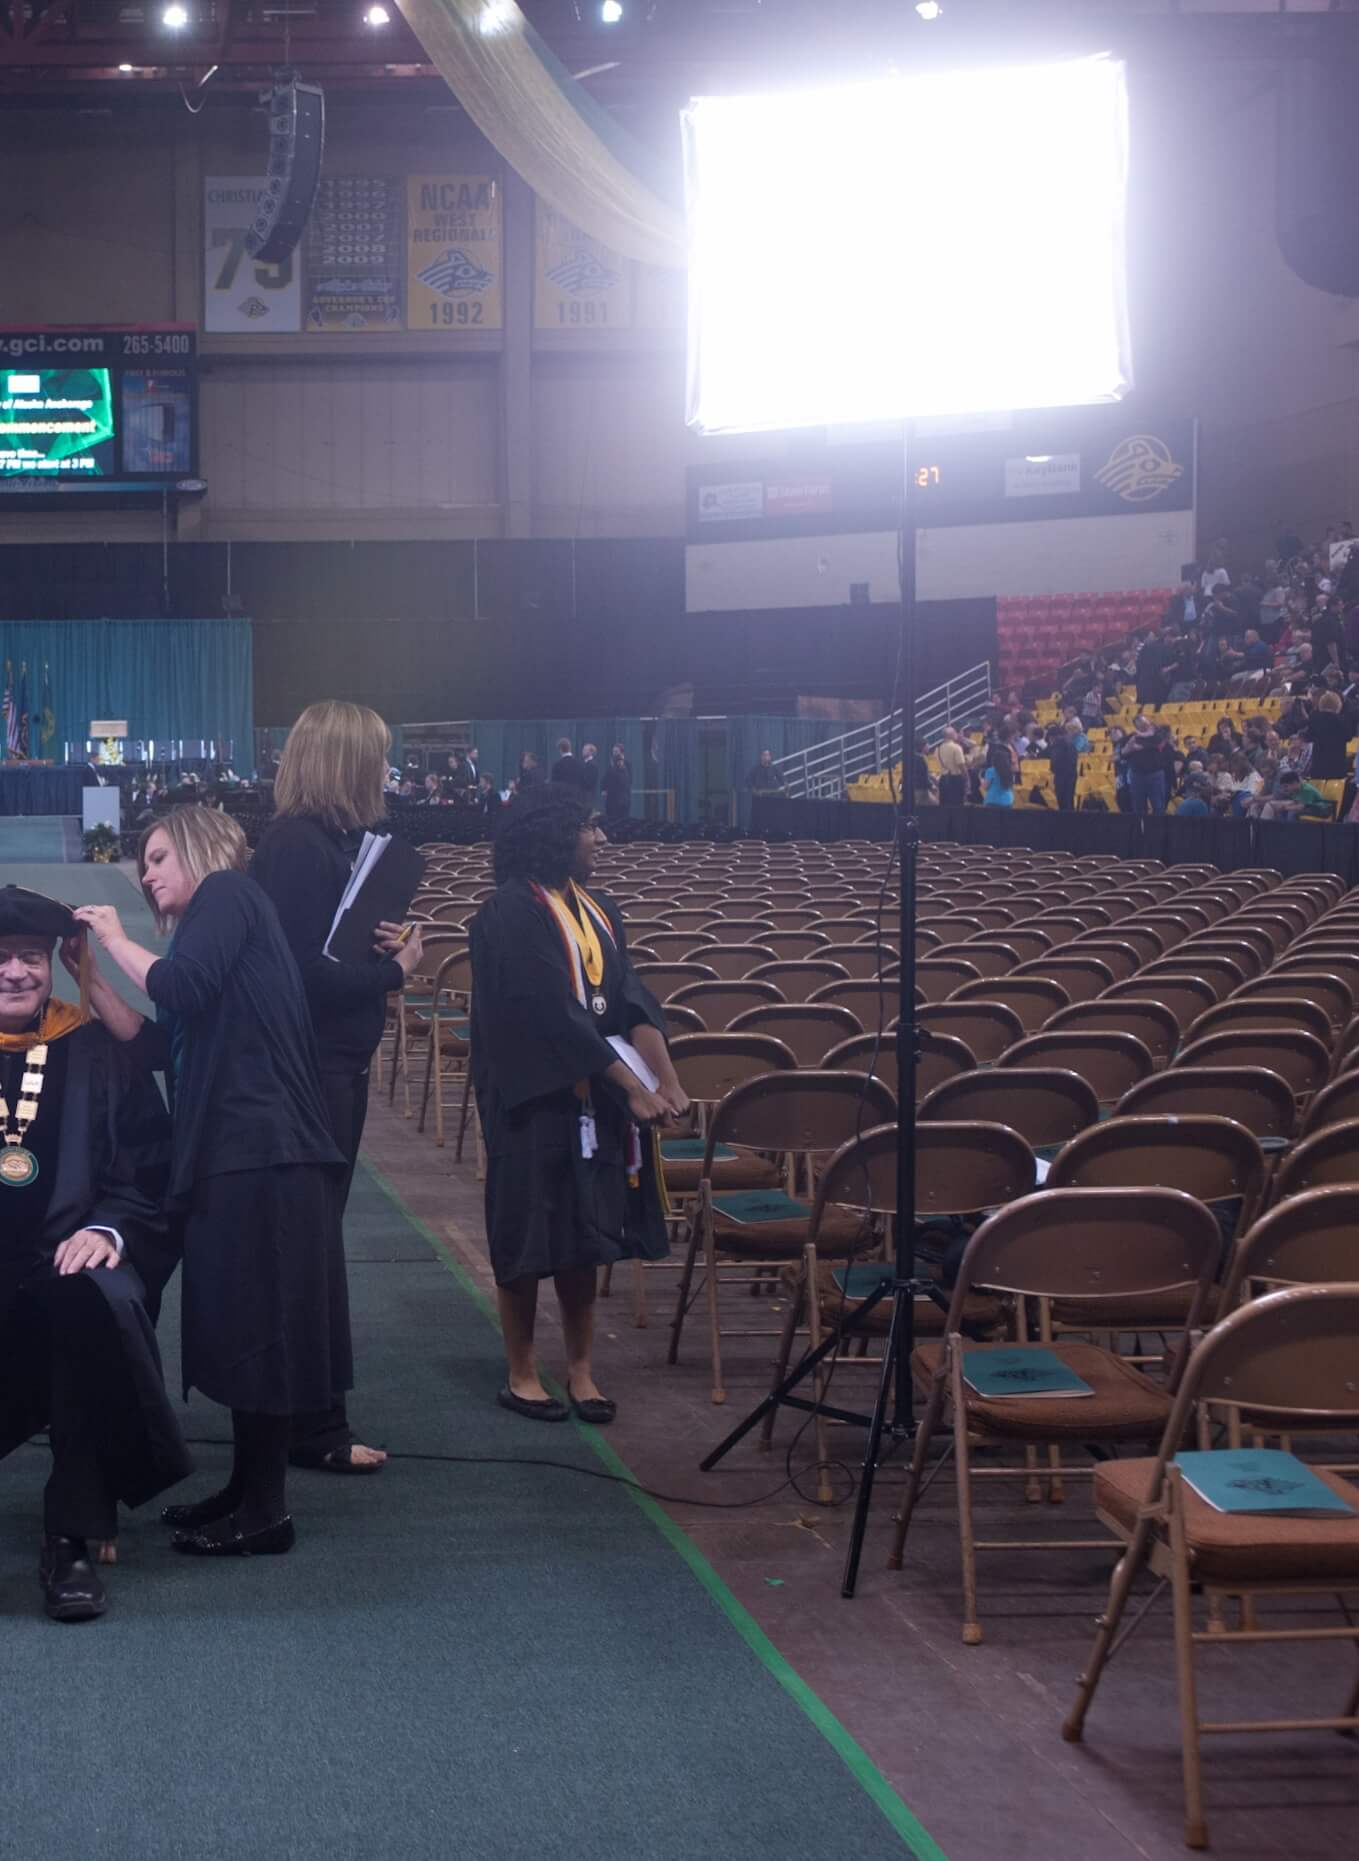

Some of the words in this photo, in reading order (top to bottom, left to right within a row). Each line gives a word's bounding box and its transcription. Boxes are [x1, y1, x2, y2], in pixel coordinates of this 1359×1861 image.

[421, 183, 491, 210] NCAA
[433, 213, 476, 226] WEST
[322, 244, 387, 254] 2008
[322, 255, 386, 265] 2009
[430, 302, 483, 325] 1992
[123, 335, 189, 354] 265-5400
[2, 398, 13, 409] of
[13, 399, 44, 410] Alaska
[45, 399, 93, 411] Anchorage
[60, 459, 71, 469] at
[72, 459, 79, 469] 3
[79, 458, 95, 469] PM
